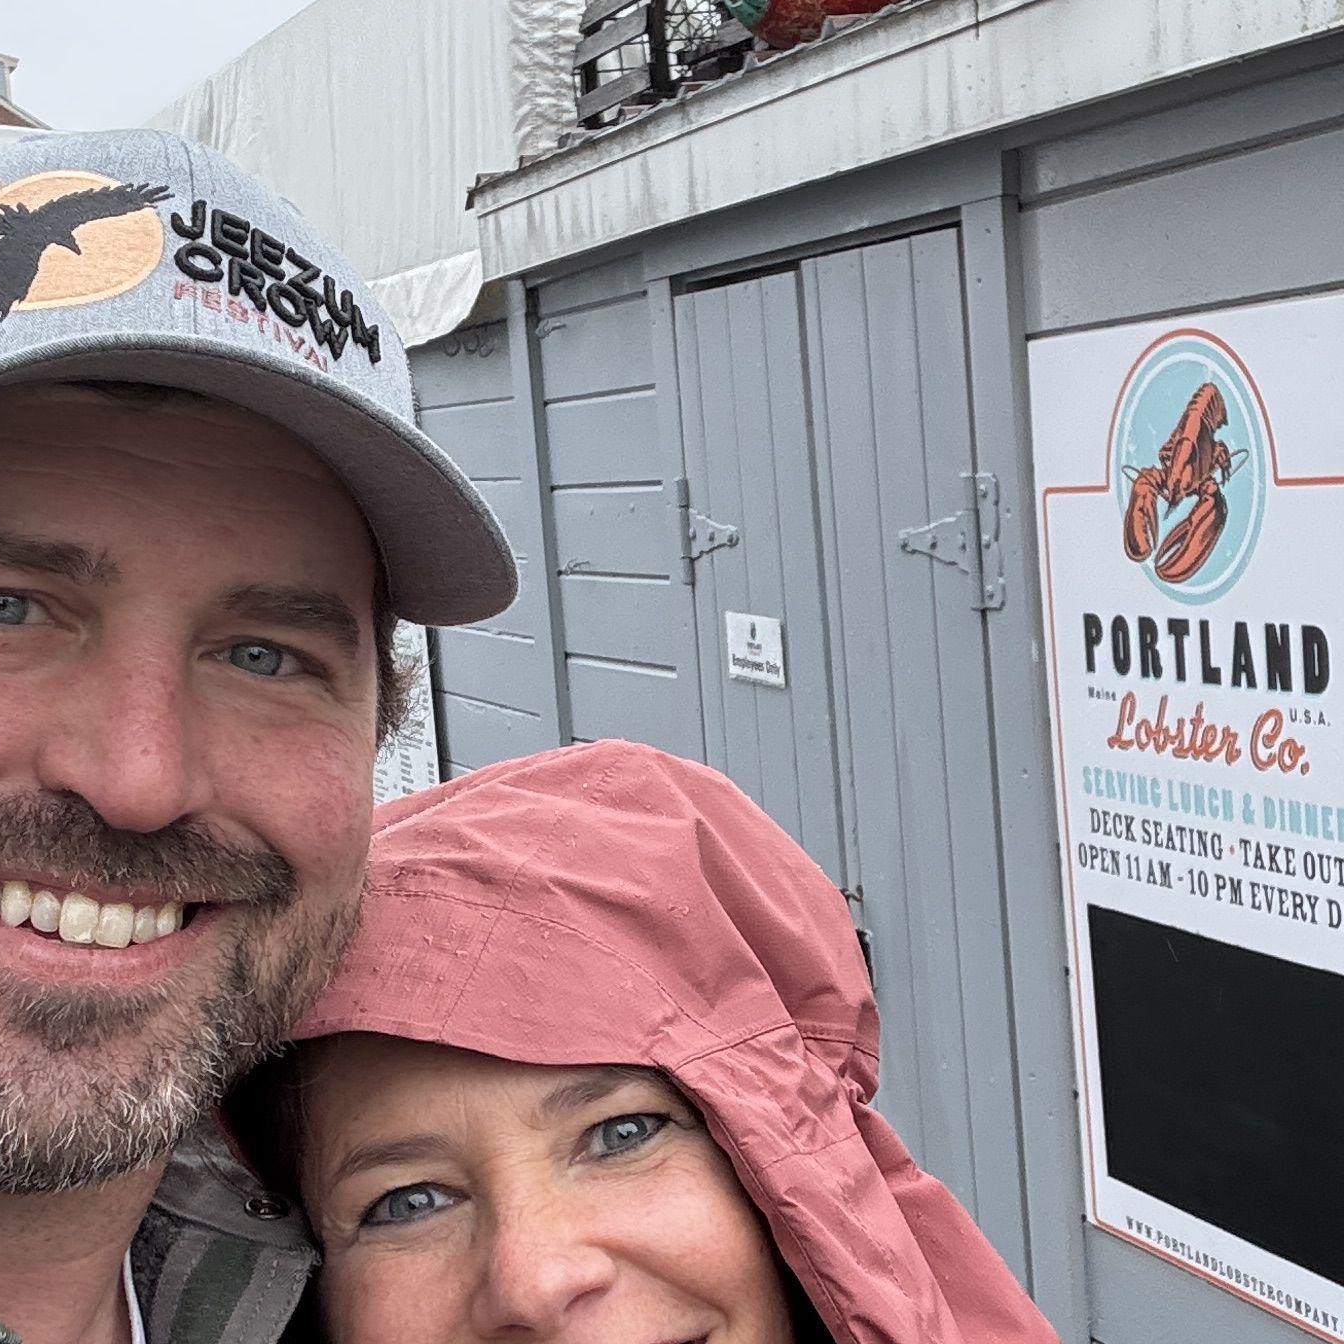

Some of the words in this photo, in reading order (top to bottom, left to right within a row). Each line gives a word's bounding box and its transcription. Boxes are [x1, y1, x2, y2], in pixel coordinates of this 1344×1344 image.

[170, 199, 381, 364] JEEZUM
[174, 241, 349, 361] CROW
[1082, 613, 1330, 694] PORTLAND
[1107, 691, 1242, 766] Lobster
[1250, 708, 1310, 775] Co.
[1289, 708, 1331, 727] U.S.A.
[1083, 765, 1161, 803] SERVING
[1167, 779, 1234, 822] LUNCH
[1242, 792, 1255, 825] &
[1078, 842, 1121, 877] OPEN
[1126, 853, 1142, 882] 11
[1146, 858, 1173, 889] AM
[1187, 868, 1209, 897] 10
[1214, 873, 1244, 906] PM
[1250, 880, 1320, 925] EVERY
[1089, 807, 1137, 843] DECK
[1141, 818, 1224, 860] SEATING
[1239, 837, 1297, 877] TAKE
